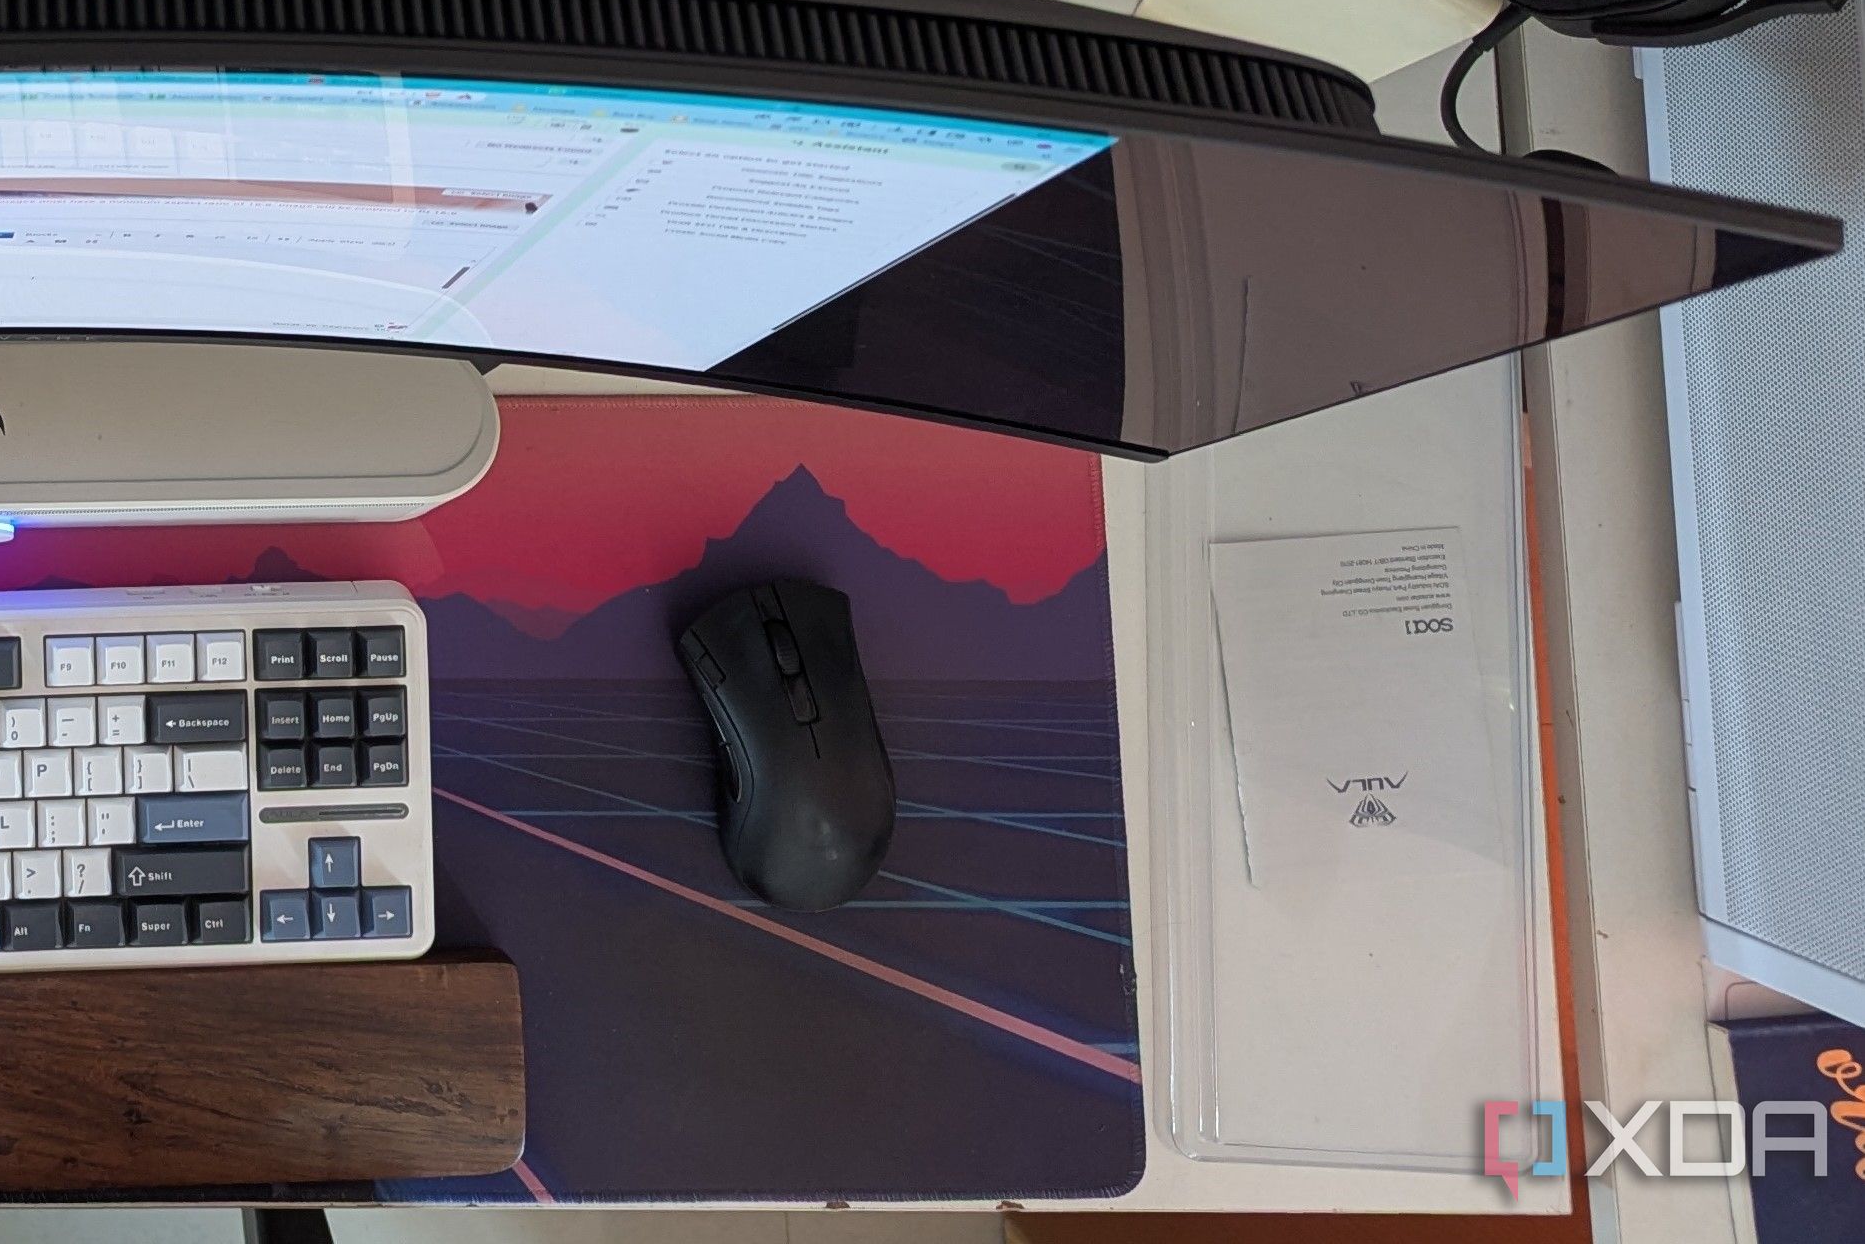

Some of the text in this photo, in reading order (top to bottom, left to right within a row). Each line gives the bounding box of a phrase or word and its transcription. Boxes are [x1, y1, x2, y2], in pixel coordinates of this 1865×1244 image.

[212, 657, 227, 666] F12
[271, 655, 294, 664] Print
[320, 654, 348, 663] Scroll
[370, 653, 398, 662] Pause
[60, 662, 72, 671] F9
[110, 661, 126, 670] F10
[161, 659, 175, 668] F11
[271, 715, 299, 724] Insert
[322, 714, 350, 723] Home
[372, 712, 398, 723] PgUp
[178, 717, 230, 728] Backspace
[11, 731, 18, 740] 0
[37, 764, 47, 777] P
[271, 765, 301, 775] Delete
[323, 763, 342, 772] End
[373, 762, 399, 771] PgDn
[1326, 771, 1408, 793] AULA
[0, 816, 10, 829] L
[177, 818, 204, 828] Enter
[77, 864, 85, 877] ?
[148, 871, 172, 881] Shift
[78, 924, 90, 932] Fn
[141, 922, 170, 931] Super
[204, 919, 223, 928] Ctrl
[14, 927, 28, 936] Alt
